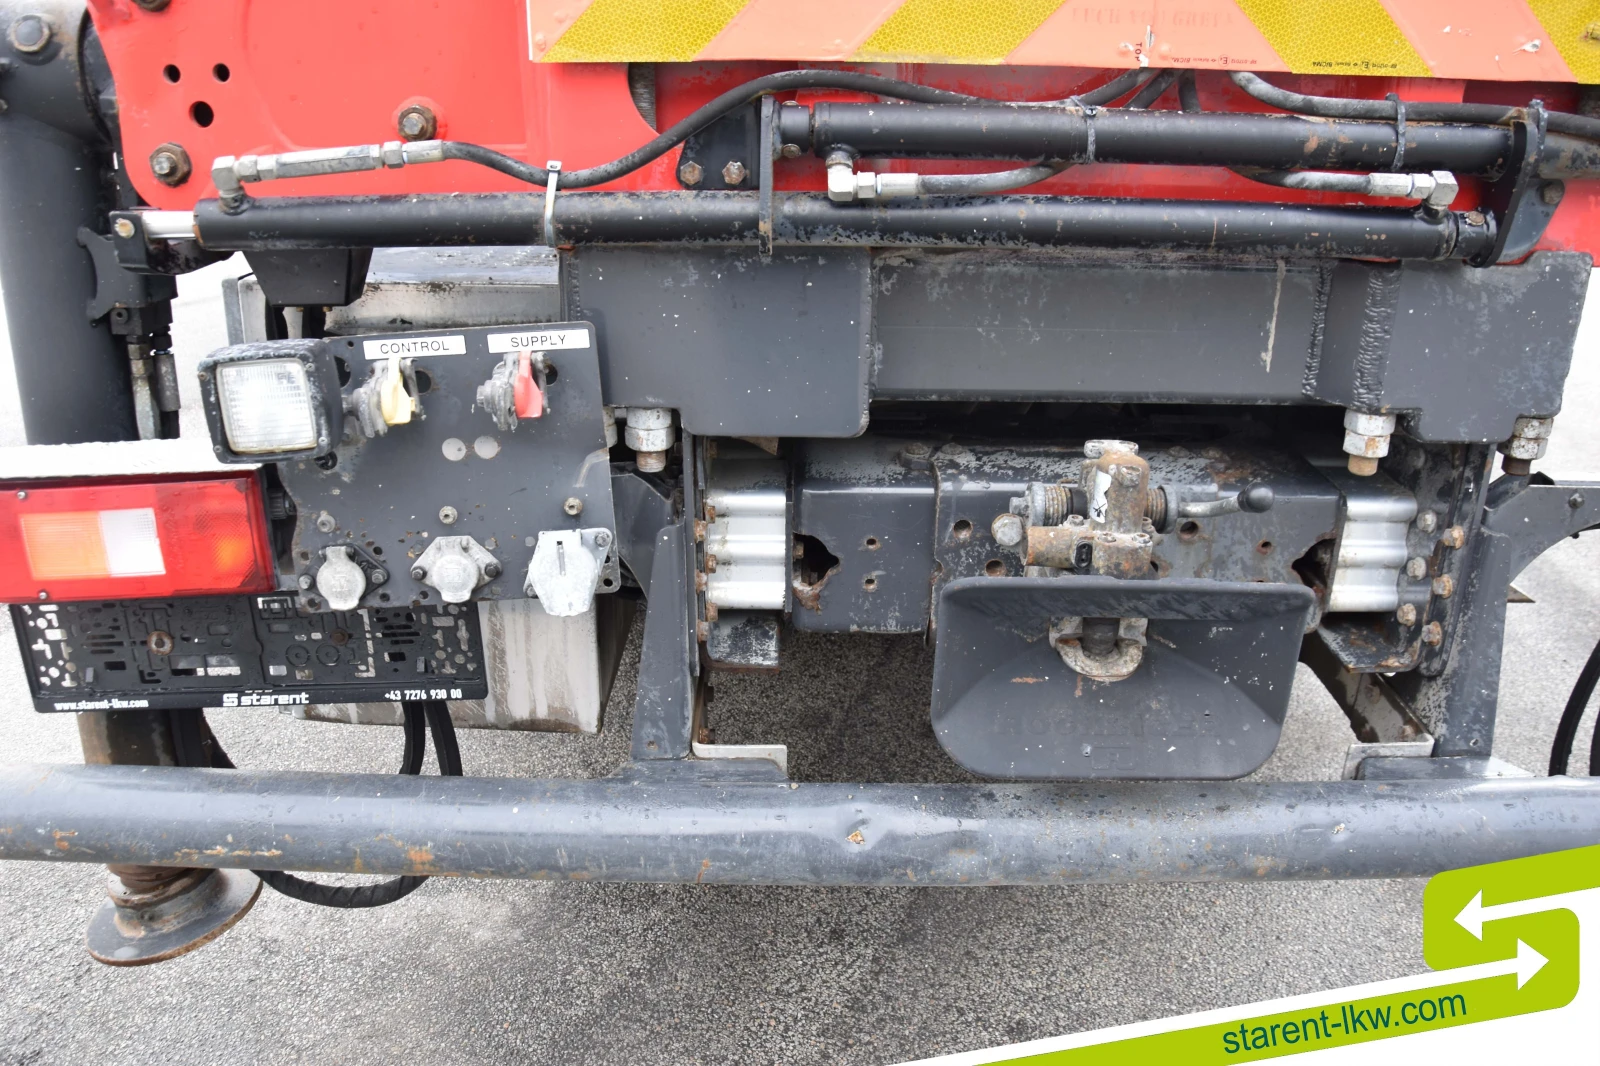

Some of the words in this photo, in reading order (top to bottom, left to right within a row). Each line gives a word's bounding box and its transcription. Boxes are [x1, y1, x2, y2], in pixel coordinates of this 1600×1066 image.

[380, 340, 450, 354] CONTROL
[510, 334, 567, 348] SUPPLY
[240, 692, 310, 706] starent
[384, 690, 402, 700] +43
[404, 690, 427, 700] 7276
[430, 689, 447, 699] 930
[450, 688, 462, 699] 00
[54, 698, 149, 711] www.starent-lkw.com
